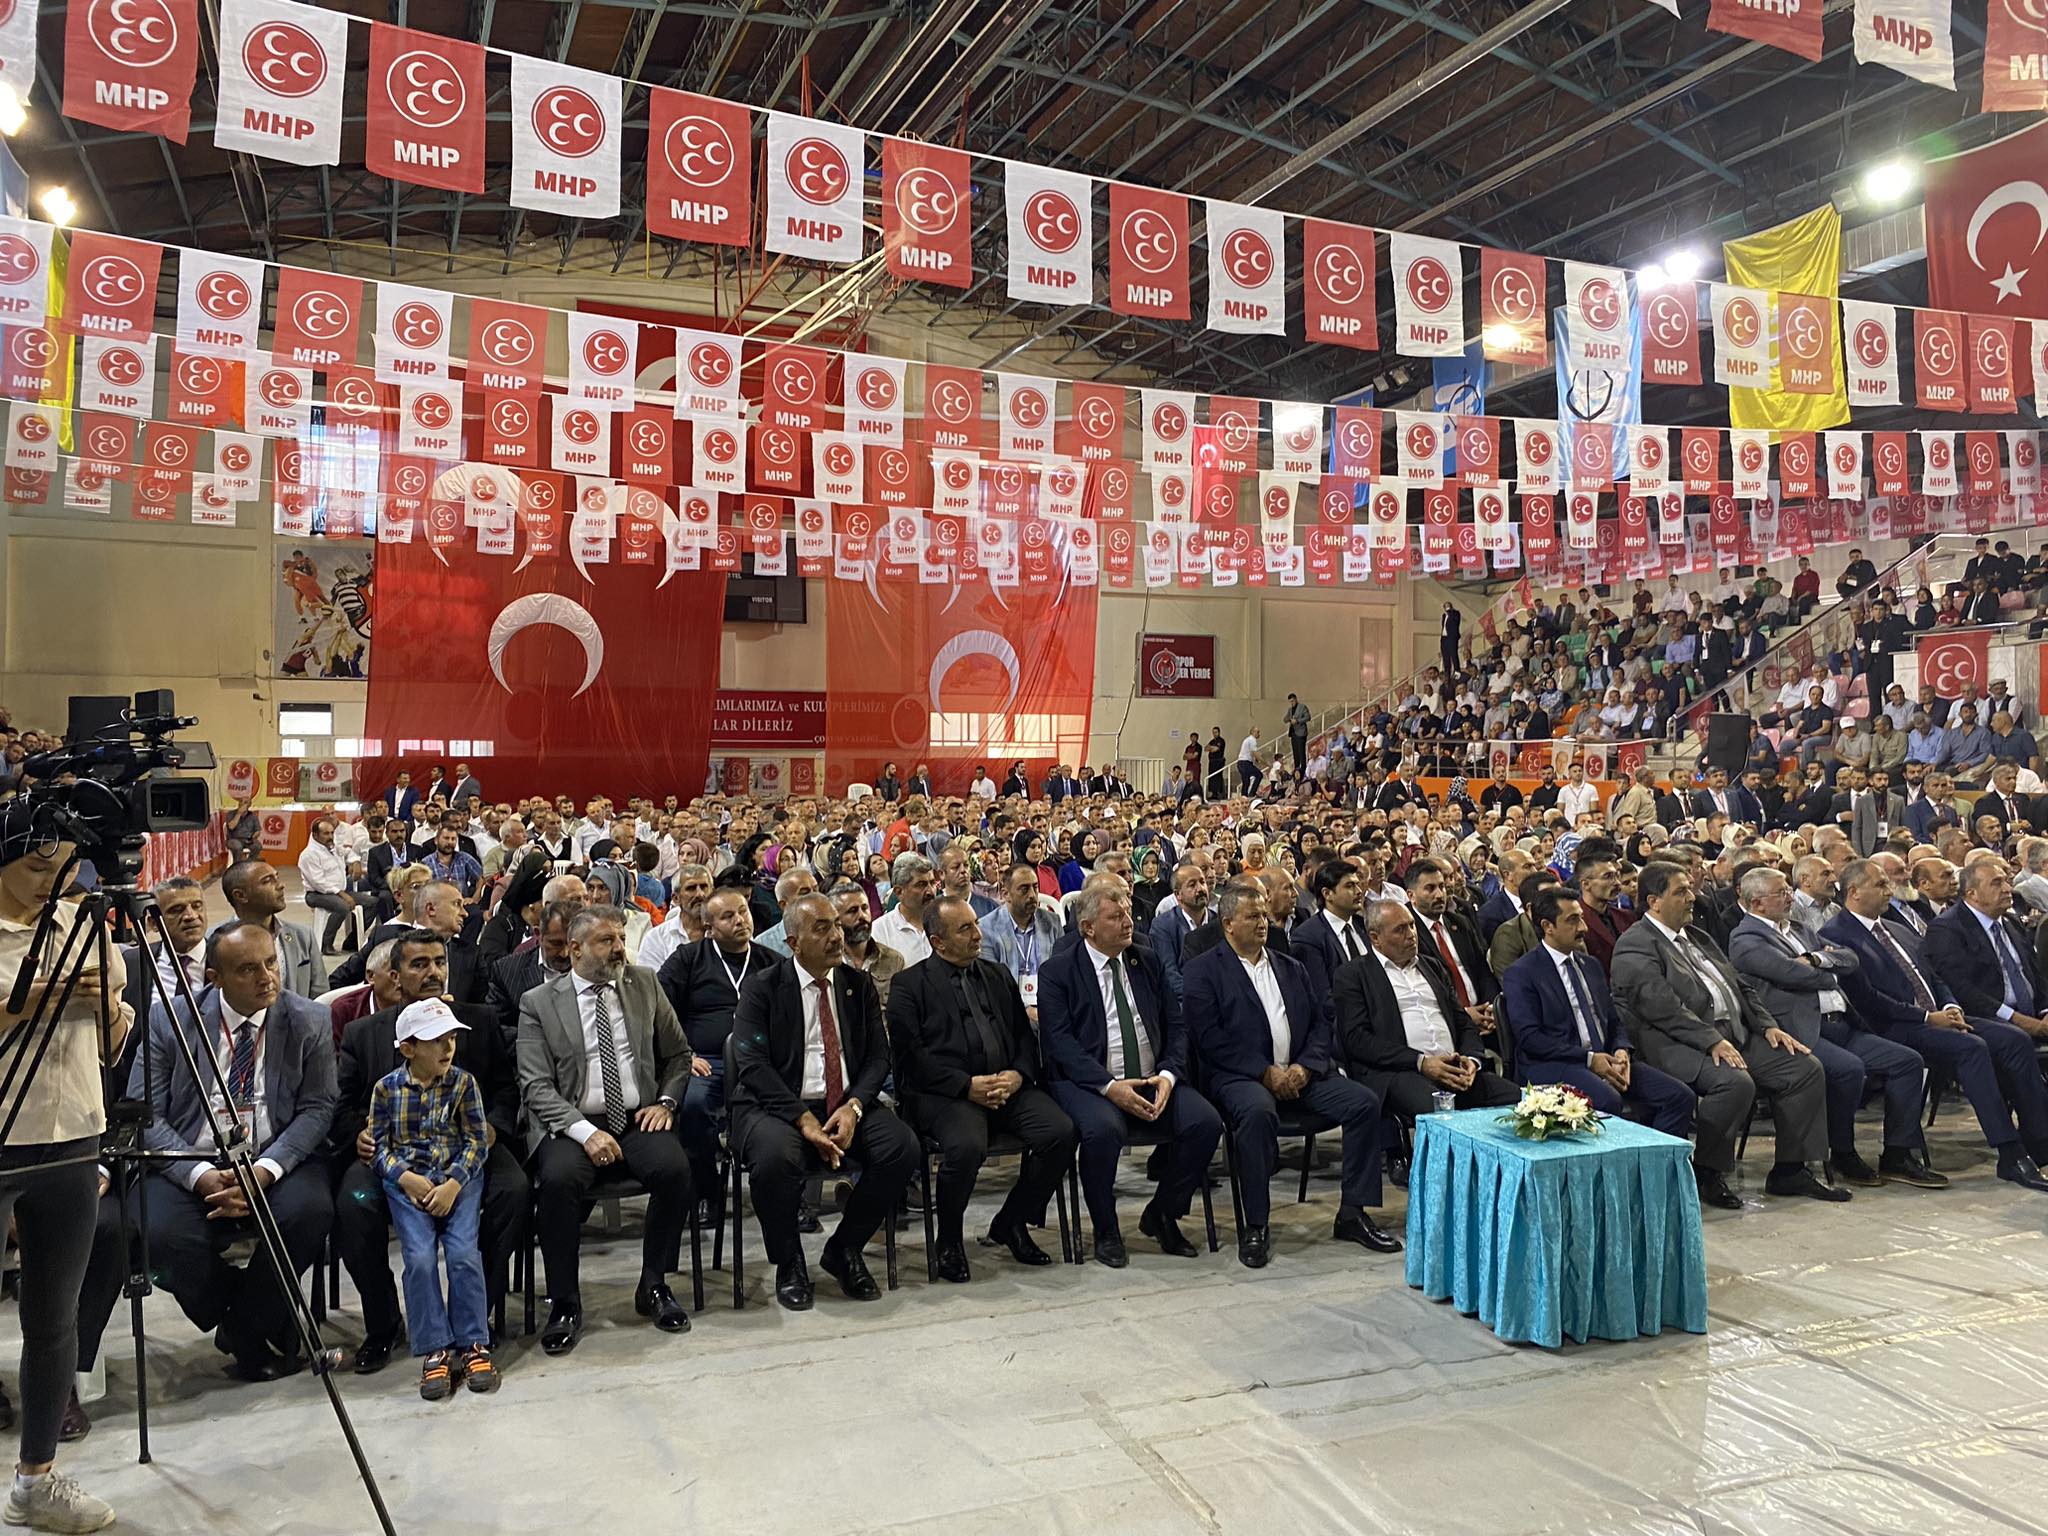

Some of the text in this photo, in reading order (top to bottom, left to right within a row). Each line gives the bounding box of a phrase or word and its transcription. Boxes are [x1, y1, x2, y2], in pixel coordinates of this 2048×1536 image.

[1874, 16, 1933, 55] MHP
[2010, 54, 2048, 80] M
[95, 80, 169, 111] MHP
[243, 108, 315, 140] MHP
[394, 140, 460, 169] MHP
[535, 170, 597, 197] MHP
[671, 199, 728, 225] MHP
[787, 217, 843, 242] MHP
[901, 247, 952, 271] MHP
[1027, 267, 1076, 289] MHP
[1127, 284, 1173, 307] MHP
[0, 296, 29, 312] HP
[1224, 300, 1268, 322] MHP
[81, 314, 133, 333] MHP
[1320, 315, 1361, 336] MHP
[196, 328, 243, 347] MHP
[1410, 325, 1448, 344] MHP
[293, 347, 340, 364] MHP
[1584, 342, 1621, 359] MHP
[393, 359, 436, 375] MHP
[1654, 358, 1688, 375] MHP
[1727, 359, 1759, 375] MHP
[12, 374, 52, 391] MHP
[483, 374, 526, 389] MHP
[1791, 369, 1822, 386] MHP
[1858, 378, 1887, 394] MHP
[584, 386, 623, 400] MHP
[1926, 385, 1955, 400] MHP
[1981, 387, 2009, 401] MHP
[99, 393, 138, 407] MHP
[690, 396, 727, 412] MHP
[180, 402, 215, 416] MHP
[261, 415, 296, 428] MHP
[776, 412, 811, 427] MHP
[336, 423, 370, 435] MHP
[859, 420, 892, 434] MHP
[414, 436, 448, 449] MHP
[936, 432, 968, 446] MHP
[1013, 438, 1044, 450] MHP
[18, 449, 46, 458] MHP
[494, 444, 525, 456] MHP
[1082, 446, 1111, 460] MHP
[565, 452, 596, 464] MHP
[1154, 452, 1182, 464] MHP
[90, 463, 120, 474] MHP
[632, 464, 662, 474] MHP
[1219, 461, 1246, 472] MHP
[1285, 462, 1312, 472] MHP
[1344, 465, 1370, 477] MHP
[154, 470, 180, 480] MHP
[705, 472, 734, 482] MHP
[765, 470, 792, 481] MHP
[1408, 468, 1434, 479] MHP
[1465, 472, 1489, 484] MHP
[223, 478, 248, 488] MHP
[1526, 475, 1550, 485] MHP
[1581, 478, 1604, 487] MHP
[1638, 479, 1661, 488] MHP
[1690, 480, 1711, 490] MHP
[1930, 477, 1950, 486] MHP
[2017, 476, 2035, 486] MHP
[282, 486, 308, 495] MHP
[826, 484, 852, 494] MHP
[1741, 482, 1761, 491] MHP
[1789, 482, 1808, 492] MHP
[1837, 483, 1855, 492] MHP
[1883, 482, 1901, 491] MHP
[1974, 481, 1993, 490] MHP
[13, 490, 39, 499] MHP
[341, 489, 364, 498] MHP
[880, 491, 906, 502] MHP
[75, 496, 100, 505] MHP
[396, 499, 420, 508] MHP
[944, 498, 969, 508] MHP
[141, 506, 166, 516] MHP
[995, 502, 1019, 512] MHP
[1050, 504, 1072, 514] MHP
[202, 512, 226, 521] MHP
[473, 508, 496, 517] MHP
[528, 513, 550, 522] MHP
[1102, 508, 1124, 517] MHP
[586, 519, 607, 527] MHP
[631, 523, 653, 532] MHP
[332, 525, 354, 534] MHP
[385, 529, 404, 537] MHP
[687, 529, 708, 537] MHP
[1812, 530, 1830, 539] MHP
[434, 535, 454, 543] MHP
[752, 534, 772, 543] MHP
[1204, 530, 1230, 541] MHP
[1324, 535, 1348, 546] MHP
[1716, 535, 1735, 544] MHP
[486, 540, 506, 548] MHP
[803, 538, 823, 546] MHP
[848, 542, 867, 551] MHP
[1430, 538, 1453, 548] MHP
[1528, 539, 1550, 548] MHP
[1625, 537, 1645, 546] MHP
[531, 543, 552, 551] MHP
[938, 548, 956, 556] MHP
[582, 550, 602, 558] MHP
[627, 552, 647, 560] MHP
[674, 556, 693, 564] MHP
[715, 559, 734, 567] MHP
[1111, 556, 1128, 564] MHP
[761, 562, 779, 570] MHP
[840, 566, 859, 574] MHP
[885, 568, 902, 576] MHP
[714, 699, 783, 711] IMLARIMIZA
[789, 703, 799, 711] ve
[743, 717, 793, 731] DİLERİZ
